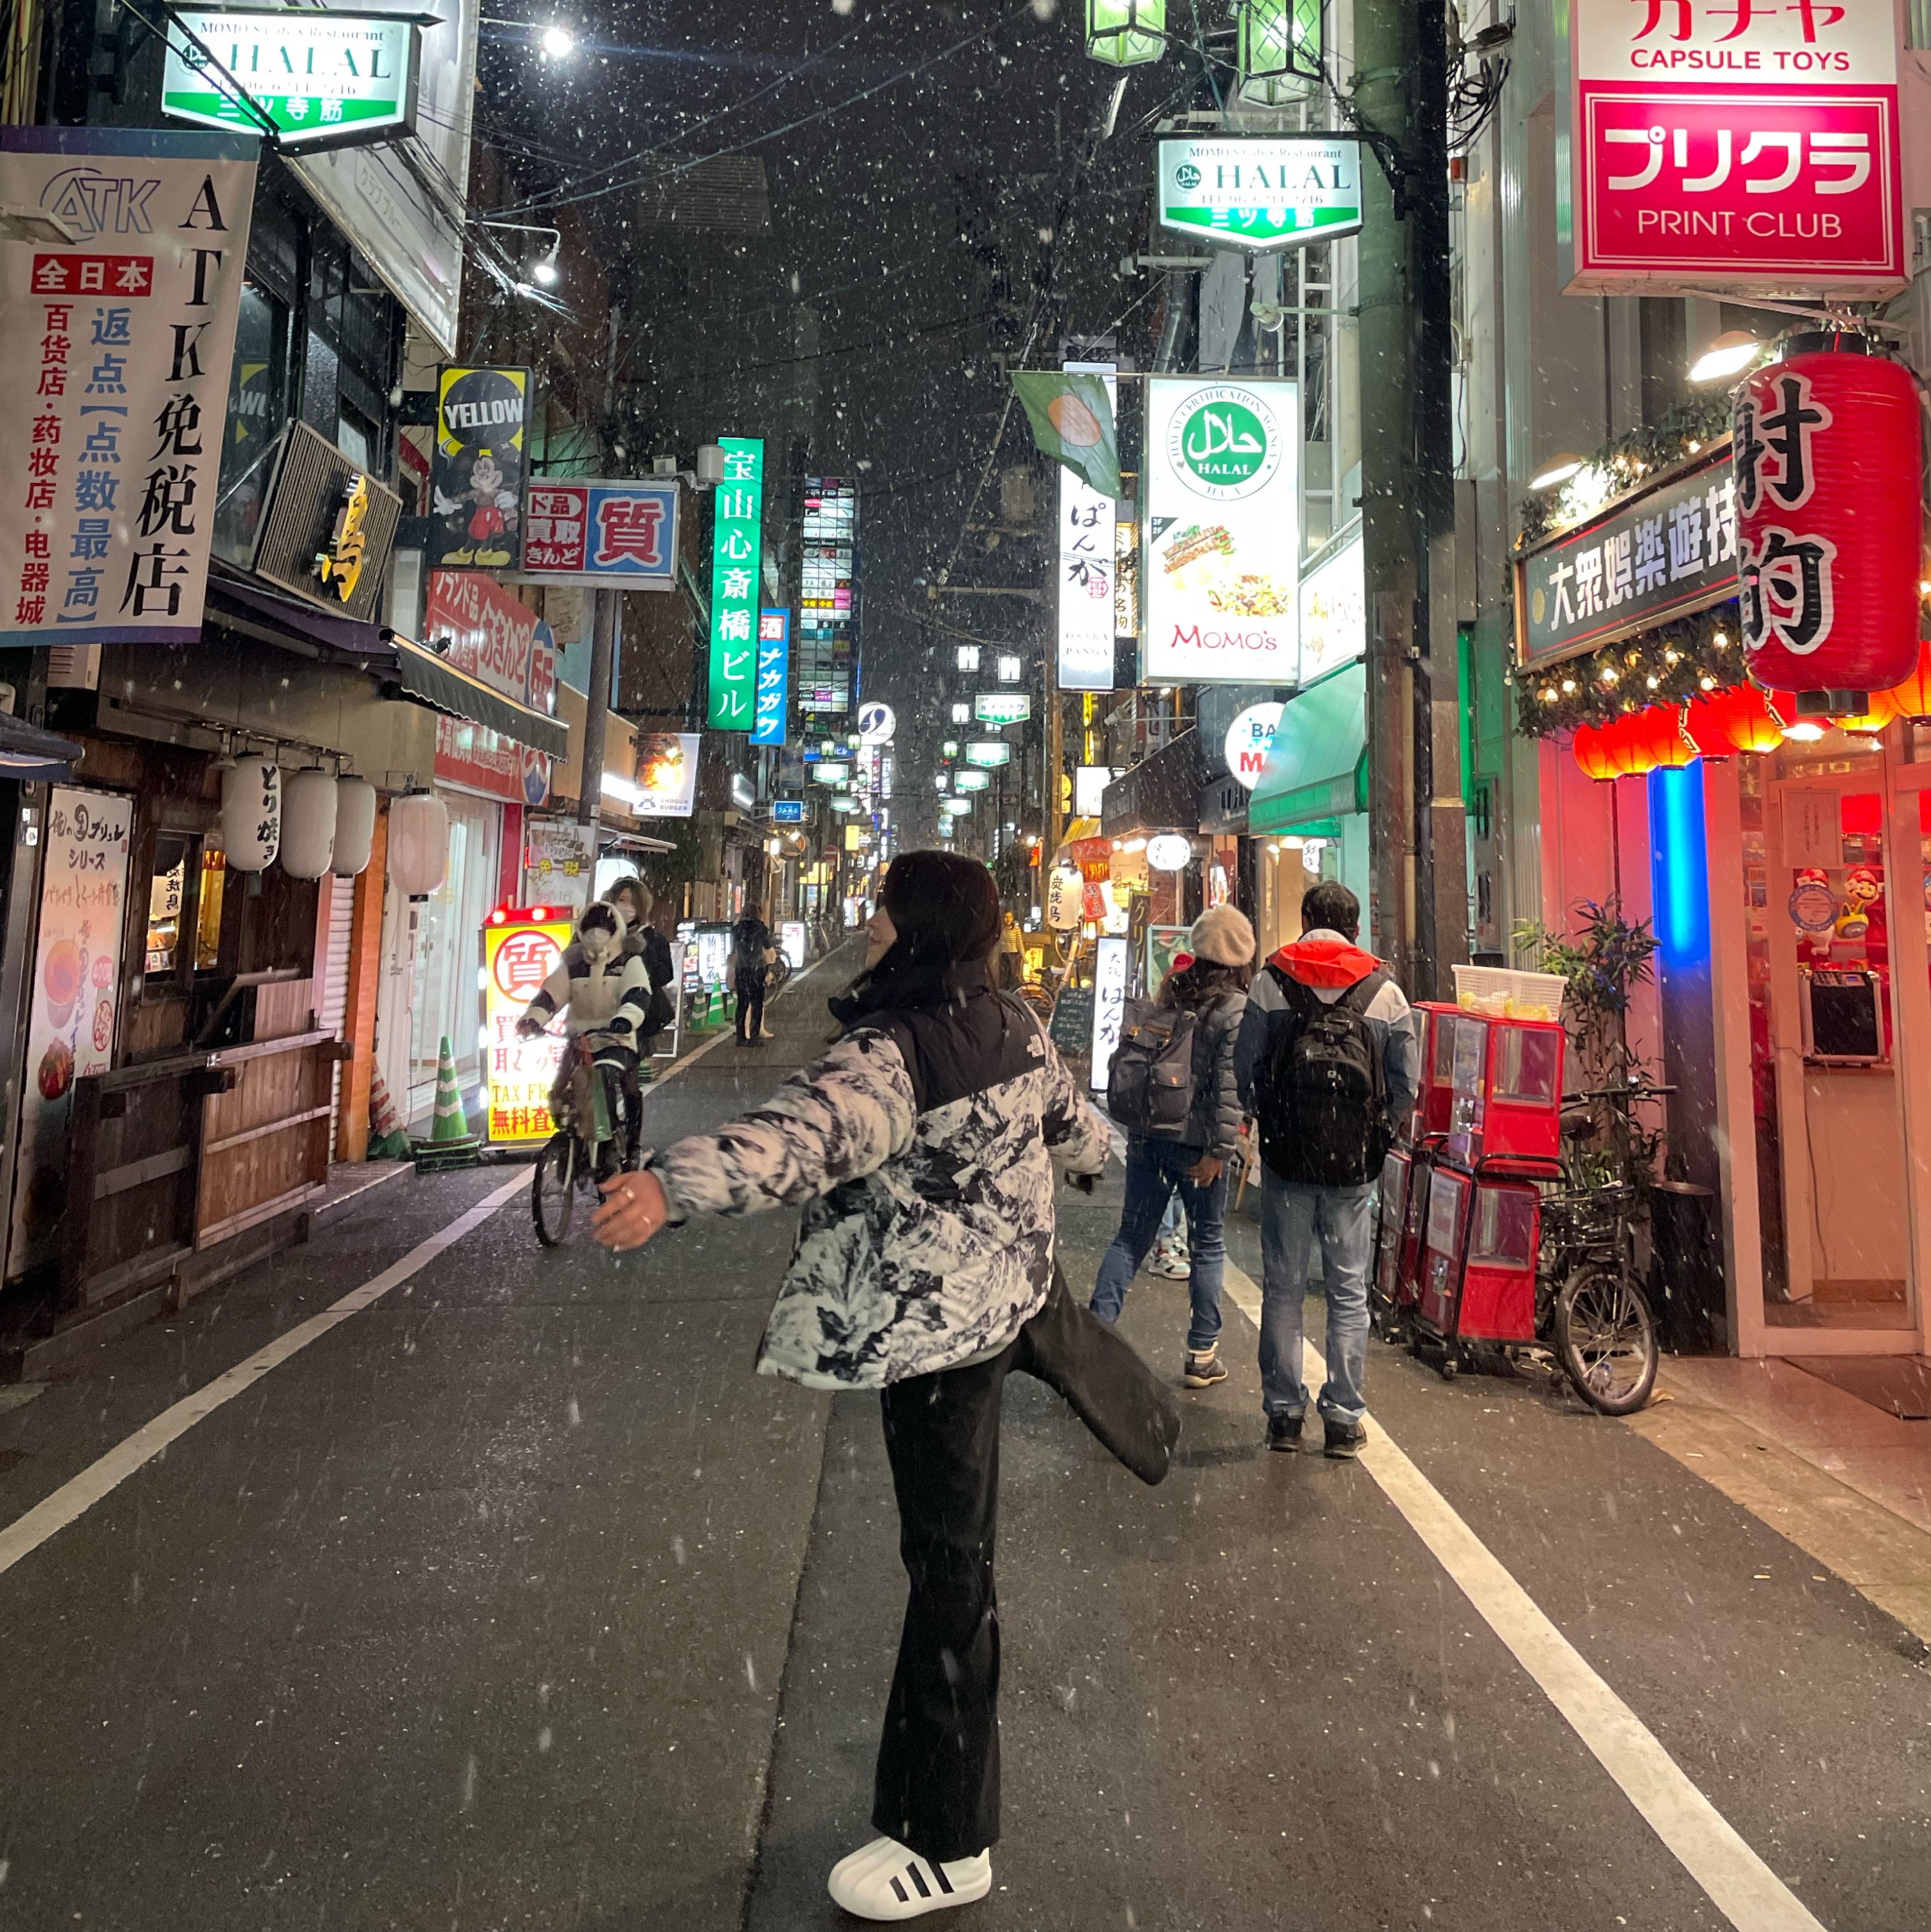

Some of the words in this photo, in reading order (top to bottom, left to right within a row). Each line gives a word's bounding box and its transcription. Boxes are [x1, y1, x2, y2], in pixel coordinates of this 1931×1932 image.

[230, 43, 391, 78] HALAL
[1630, 49, 1761, 69] CAPSULE
[1773, 51, 1850, 71] TOYS
[1216, 164, 1351, 189] HALAL
[1604, 125, 1871, 194] プリクラ
[54, 178, 161, 234] ATK
[1638, 209, 1736, 236] PRINT
[1746, 210, 1843, 238] CLUB
[36, 259, 149, 294] 全日本
[119, 174, 229, 617] ATK免税店
[445, 397, 523, 430] YELLOW
[1188, 409, 1263, 460] حلال
[1198, 463, 1252, 475] HALAL
[531, 494, 570, 515] ド品
[1733, 374, 1834, 650] 射的
[527, 519, 580, 545] 買取
[596, 499, 662, 563] 質
[718, 450, 755, 717] 宝山心斎橋ビル
[761, 618, 782, 639] 酒
[257, 766, 278, 860] とり焼き
[503, 943, 553, 998] 質
[492, 1084, 519, 1103] TAX
